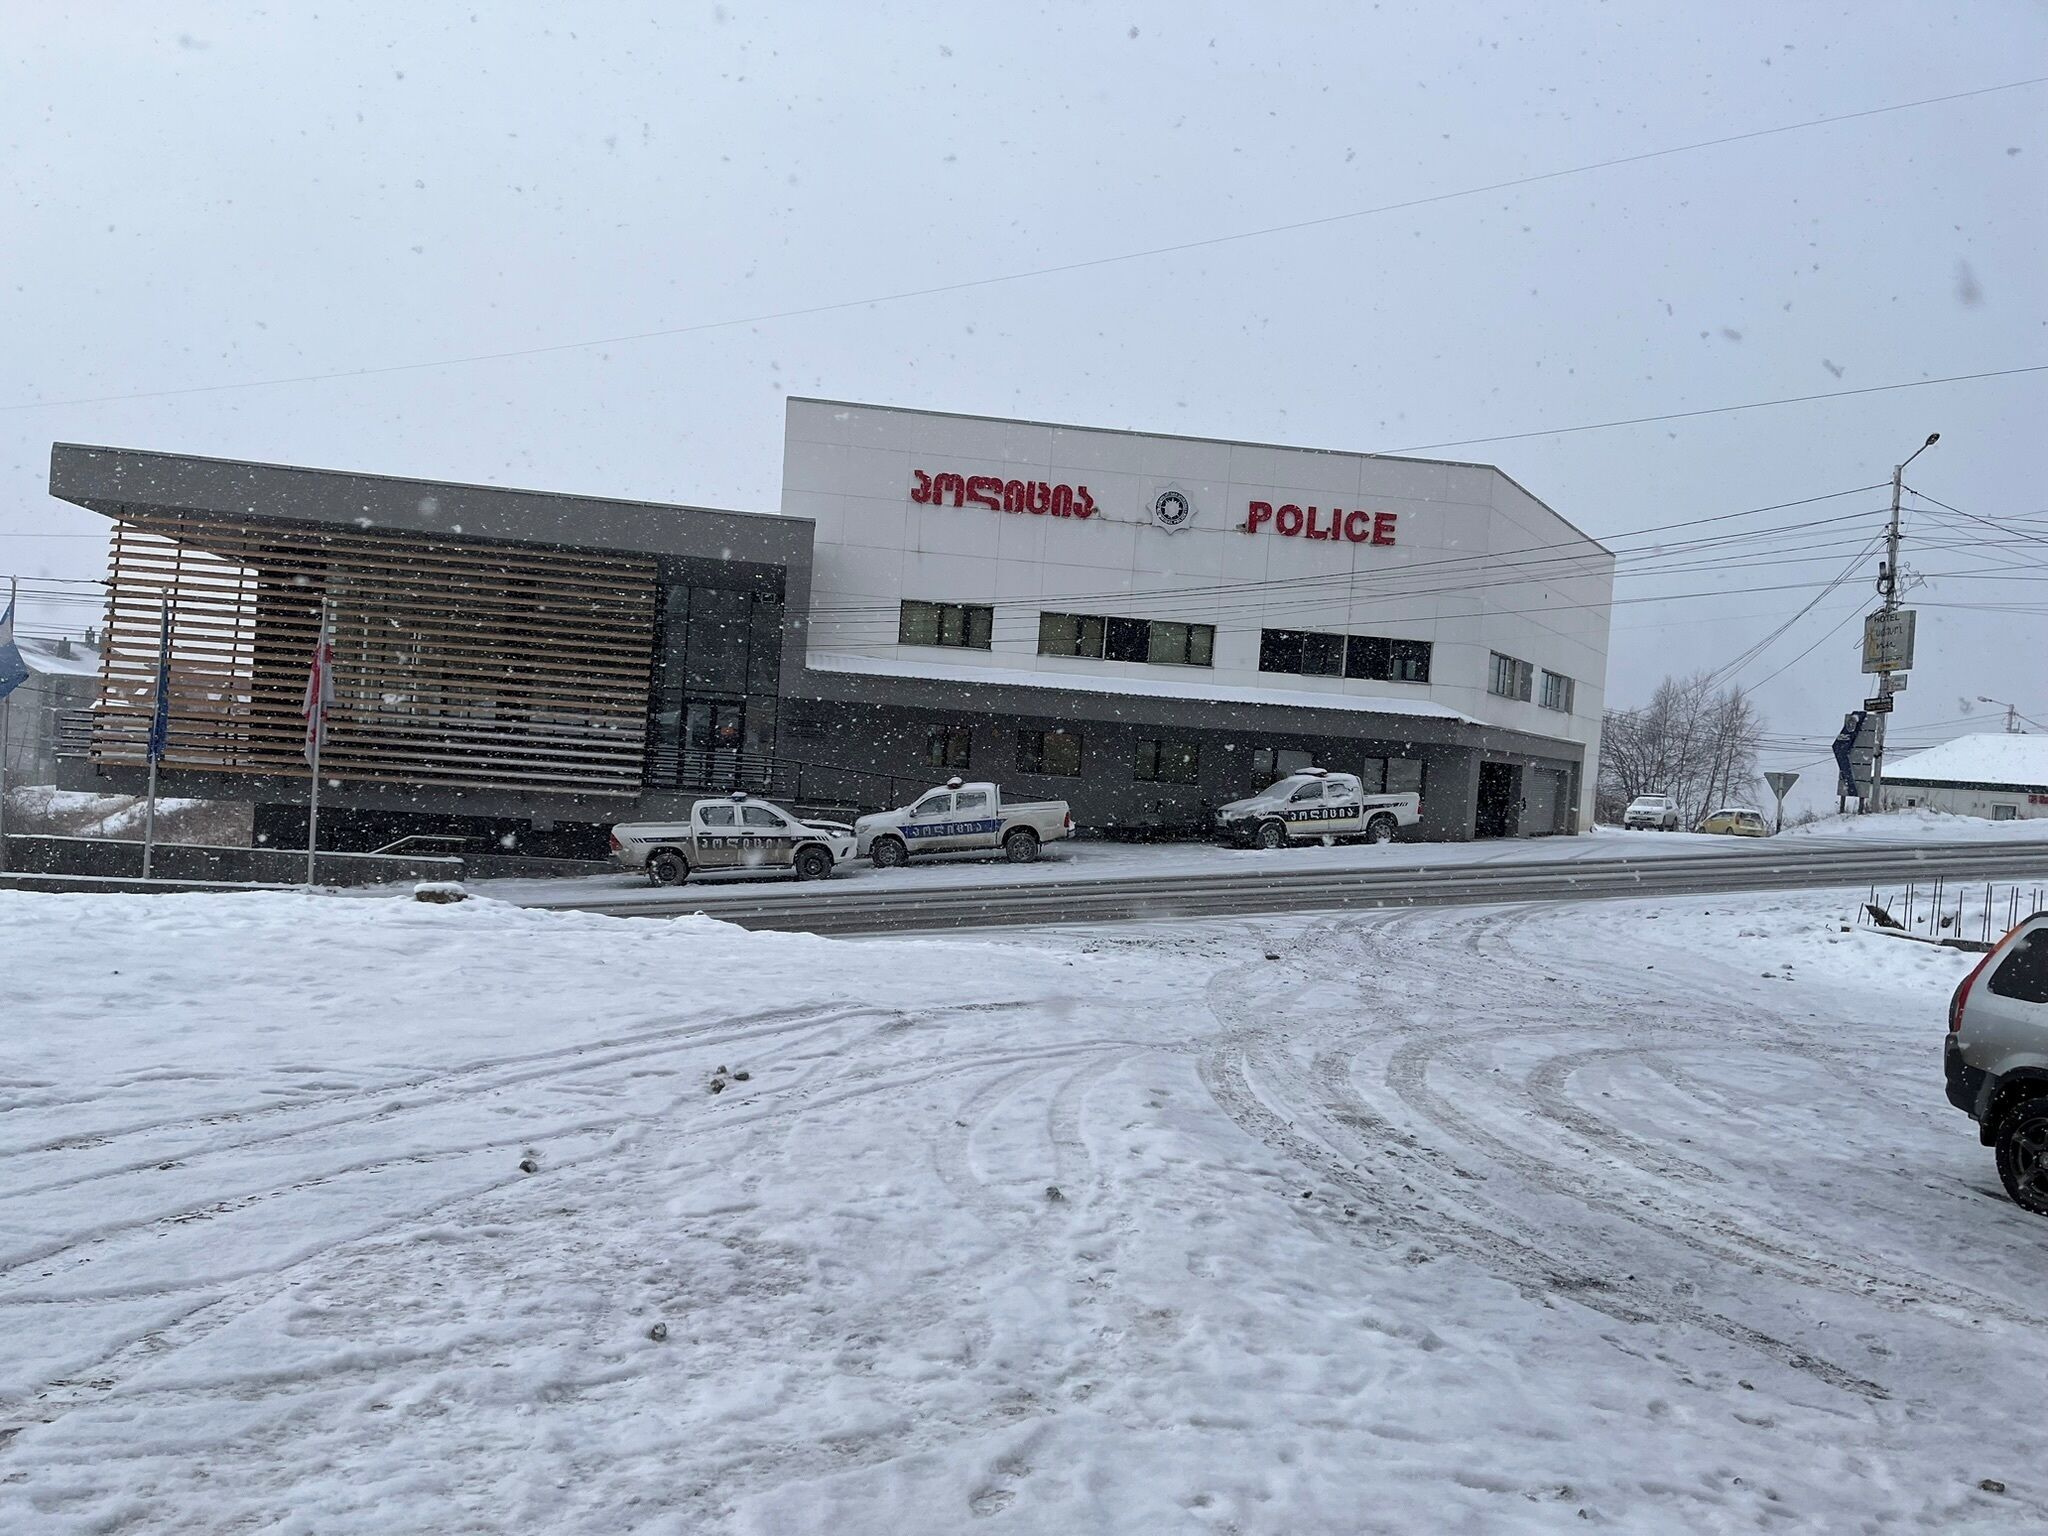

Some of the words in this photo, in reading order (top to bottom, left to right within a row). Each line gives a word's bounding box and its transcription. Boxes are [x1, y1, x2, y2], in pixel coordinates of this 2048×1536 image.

[911, 470, 1094, 518] პოლიცია
[1248, 501, 1397, 545] POLICE
[1874, 613, 1900, 623] HOTEL
[1290, 808, 1353, 821] პოლიცია
[912, 822, 982, 837] პოლიცია
